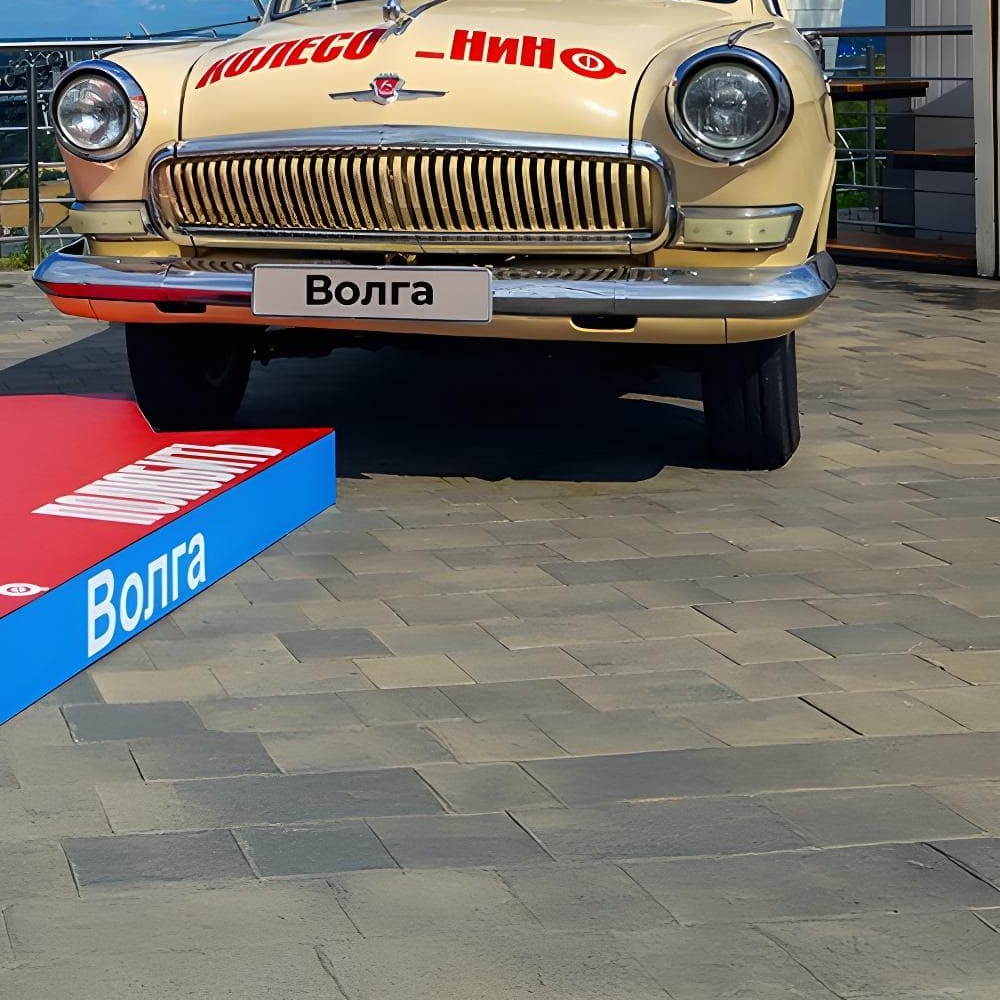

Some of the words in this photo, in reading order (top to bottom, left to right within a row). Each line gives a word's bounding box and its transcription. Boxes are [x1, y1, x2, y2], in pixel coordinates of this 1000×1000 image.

[305, 274, 434, 306] Волга
[31, 443, 283, 526] ПОЛЮБИТЬ
[86, 532, 207, 658] Волга
